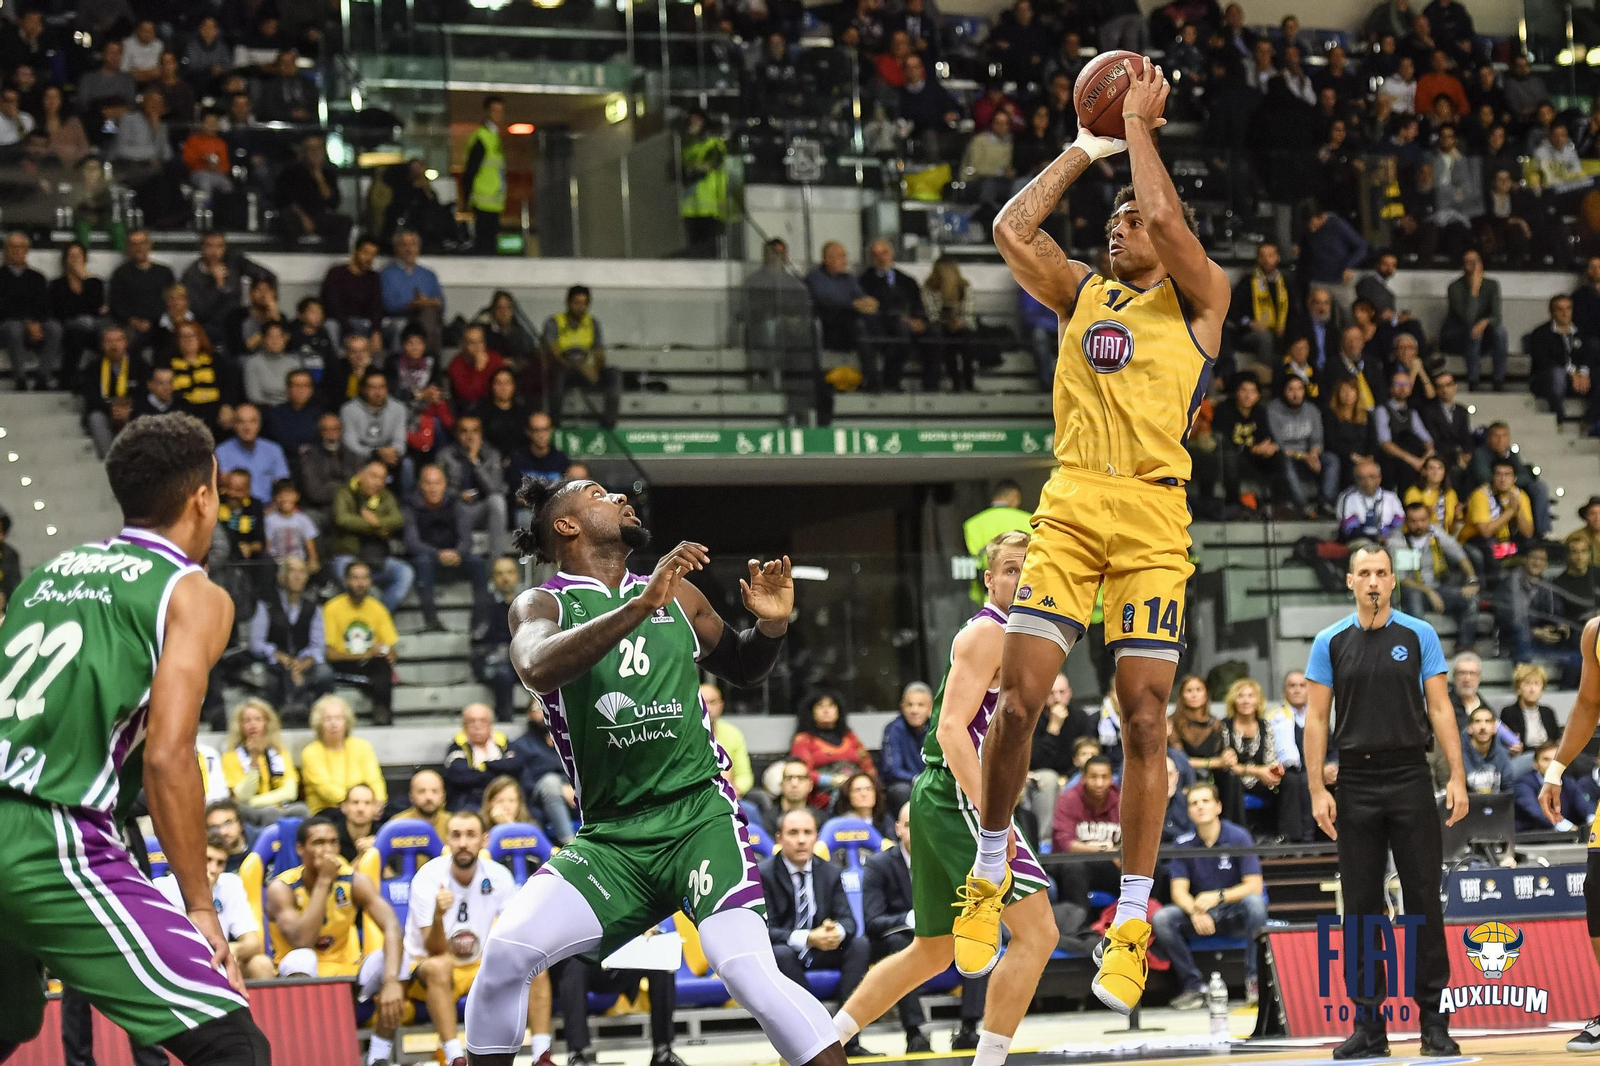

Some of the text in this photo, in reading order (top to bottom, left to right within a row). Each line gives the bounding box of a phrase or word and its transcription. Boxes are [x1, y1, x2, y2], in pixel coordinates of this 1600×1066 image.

[1092, 335, 1123, 360] FIAT
[44, 552, 153, 582] ROBERTS
[1143, 596, 1178, 638] 14
[0, 621, 83, 721] 22
[618, 636, 650, 679] 26
[634, 698, 683, 718] Unicaja
[607, 722, 678, 749] Andalucía
[587, 874, 611, 900] SPALDING
[688, 859, 713, 908] 26
[1459, 878, 1481, 899] FIAT
[1513, 875, 1534, 896] FIAT
